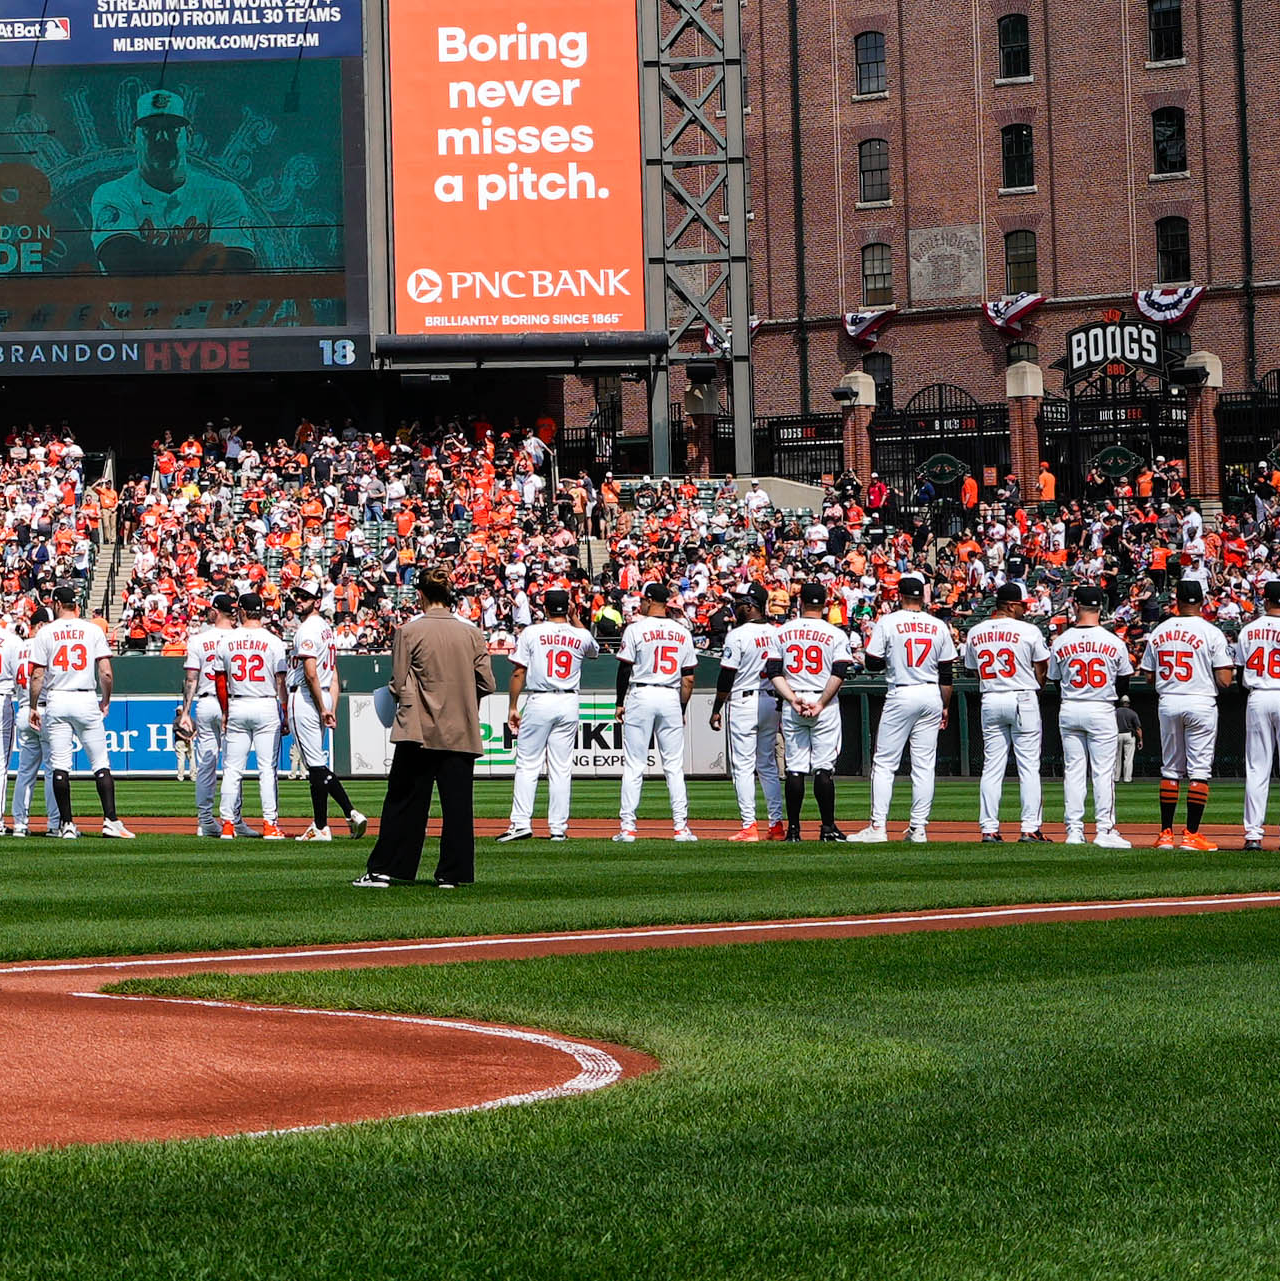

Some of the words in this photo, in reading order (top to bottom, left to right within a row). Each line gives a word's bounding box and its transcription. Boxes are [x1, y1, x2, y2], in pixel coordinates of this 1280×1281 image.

[93, 13, 128, 29] LIVE
[132, 11, 177, 27] AUDIO
[182, 10, 229, 26] FROM
[232, 9, 262, 25] ALL
[262, 9, 284, 24] 30
[285, 6, 342, 23] TEAMS
[113, 32, 320, 52] MLBNETWORK.COM/STREAM
[437, 22, 588, 68] Boring
[449, 78, 581, 109] never
[437, 116, 594, 156] misses
[434, 173, 464, 203] a
[477, 162, 610, 211] pitch.
[447, 270, 526, 300] PNC
[528, 268, 632, 298] BANK
[425, 314, 501, 328] BRILLIANTLY
[502, 313, 551, 326] BORING
[552, 313, 590, 325] SINCE
[144, 340, 250, 371] HYDE
[318, 339, 357, 367] 18
[1106, 363, 1126, 376] BBQ
[52, 629, 85, 641] BAKER
[539, 634, 582, 650] SUGANO
[642, 632, 686, 645] CARLSON
[778, 629, 834, 647] KITTREDGE
[896, 622, 938, 636] COWSER
[971, 630, 1021, 647] CHIRINOS
[1152, 630, 1204, 650] SANDERS
[52, 643, 88, 672] 43
[228, 639, 269, 652] O'HEARN
[786, 644, 823, 675] 39
[904, 638, 933, 668] 17
[1055, 641, 1117, 661] MANSOLINO
[230, 654, 266, 682] 32
[545, 649, 573, 679] 19
[652, 646, 679, 675] 15
[977, 647, 1018, 680] 23
[1068, 657, 1107, 689] 36
[1157, 650, 1194, 682] 55
